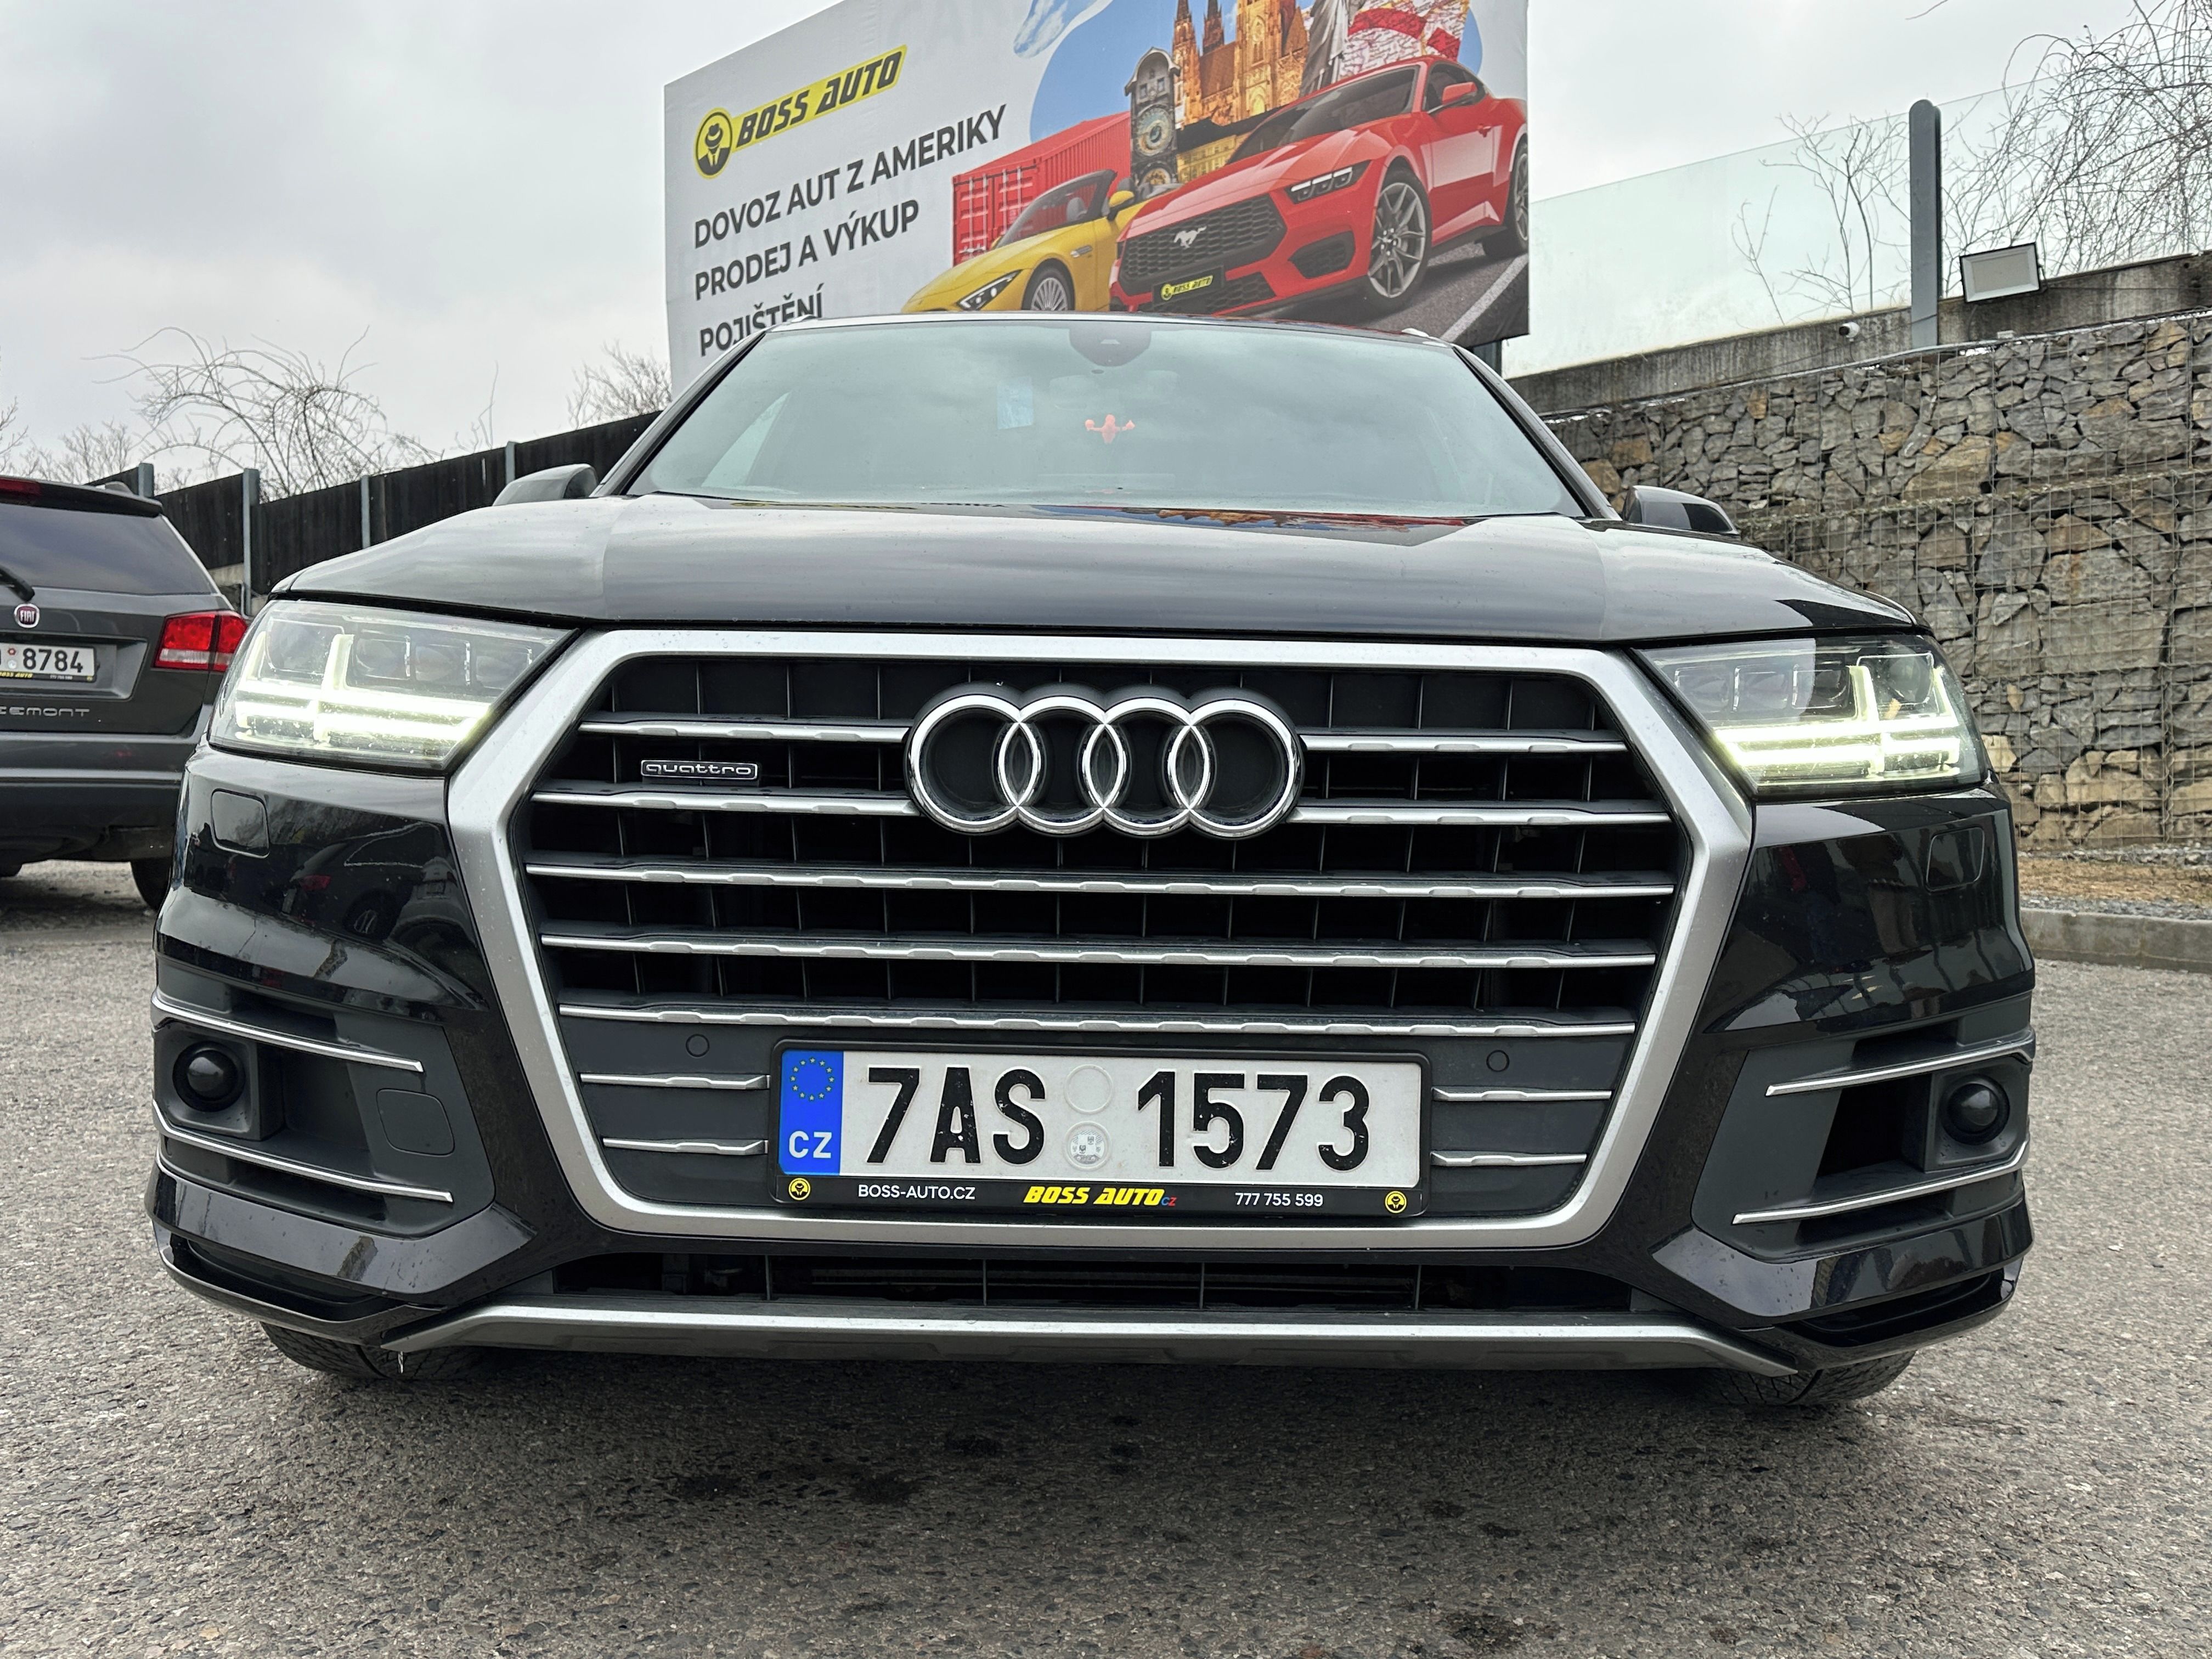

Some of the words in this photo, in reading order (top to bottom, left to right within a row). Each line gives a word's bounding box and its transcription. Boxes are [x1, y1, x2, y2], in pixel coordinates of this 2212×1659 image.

[736, 90, 810, 148] BOSS
[814, 51, 902, 115] AUTO
[695, 190, 781, 249] DOVOZ
[786, 168, 840, 216] AUT
[847, 159, 864, 194] Z
[870, 104, 1007, 185] AMERIKY
[695, 242, 792, 301] PRODEJ
[798, 234, 819, 267] A
[823, 200, 919, 257] VÝKUP
[699, 283, 824, 357] POJIŠTĚNÍ
[20, 610, 35, 622] FIAT
[22, 648, 83, 673] 8784
[646, 764, 752, 775] quattro
[866, 1066, 1046, 1165] 7AS
[1138, 1071, 1370, 1172] 1573
[788, 1130, 832, 1159] CZ
[858, 1184, 976, 1200] BOSS-AUTO.CZ
[1023, 1186, 1091, 1204] BOSS
[1093, 1187, 1165, 1206] AUTO
[1235, 1192, 1260, 1205] 777
[1263, 1193, 1291, 1206] 755
[1295, 1193, 1323, 1207] 599
